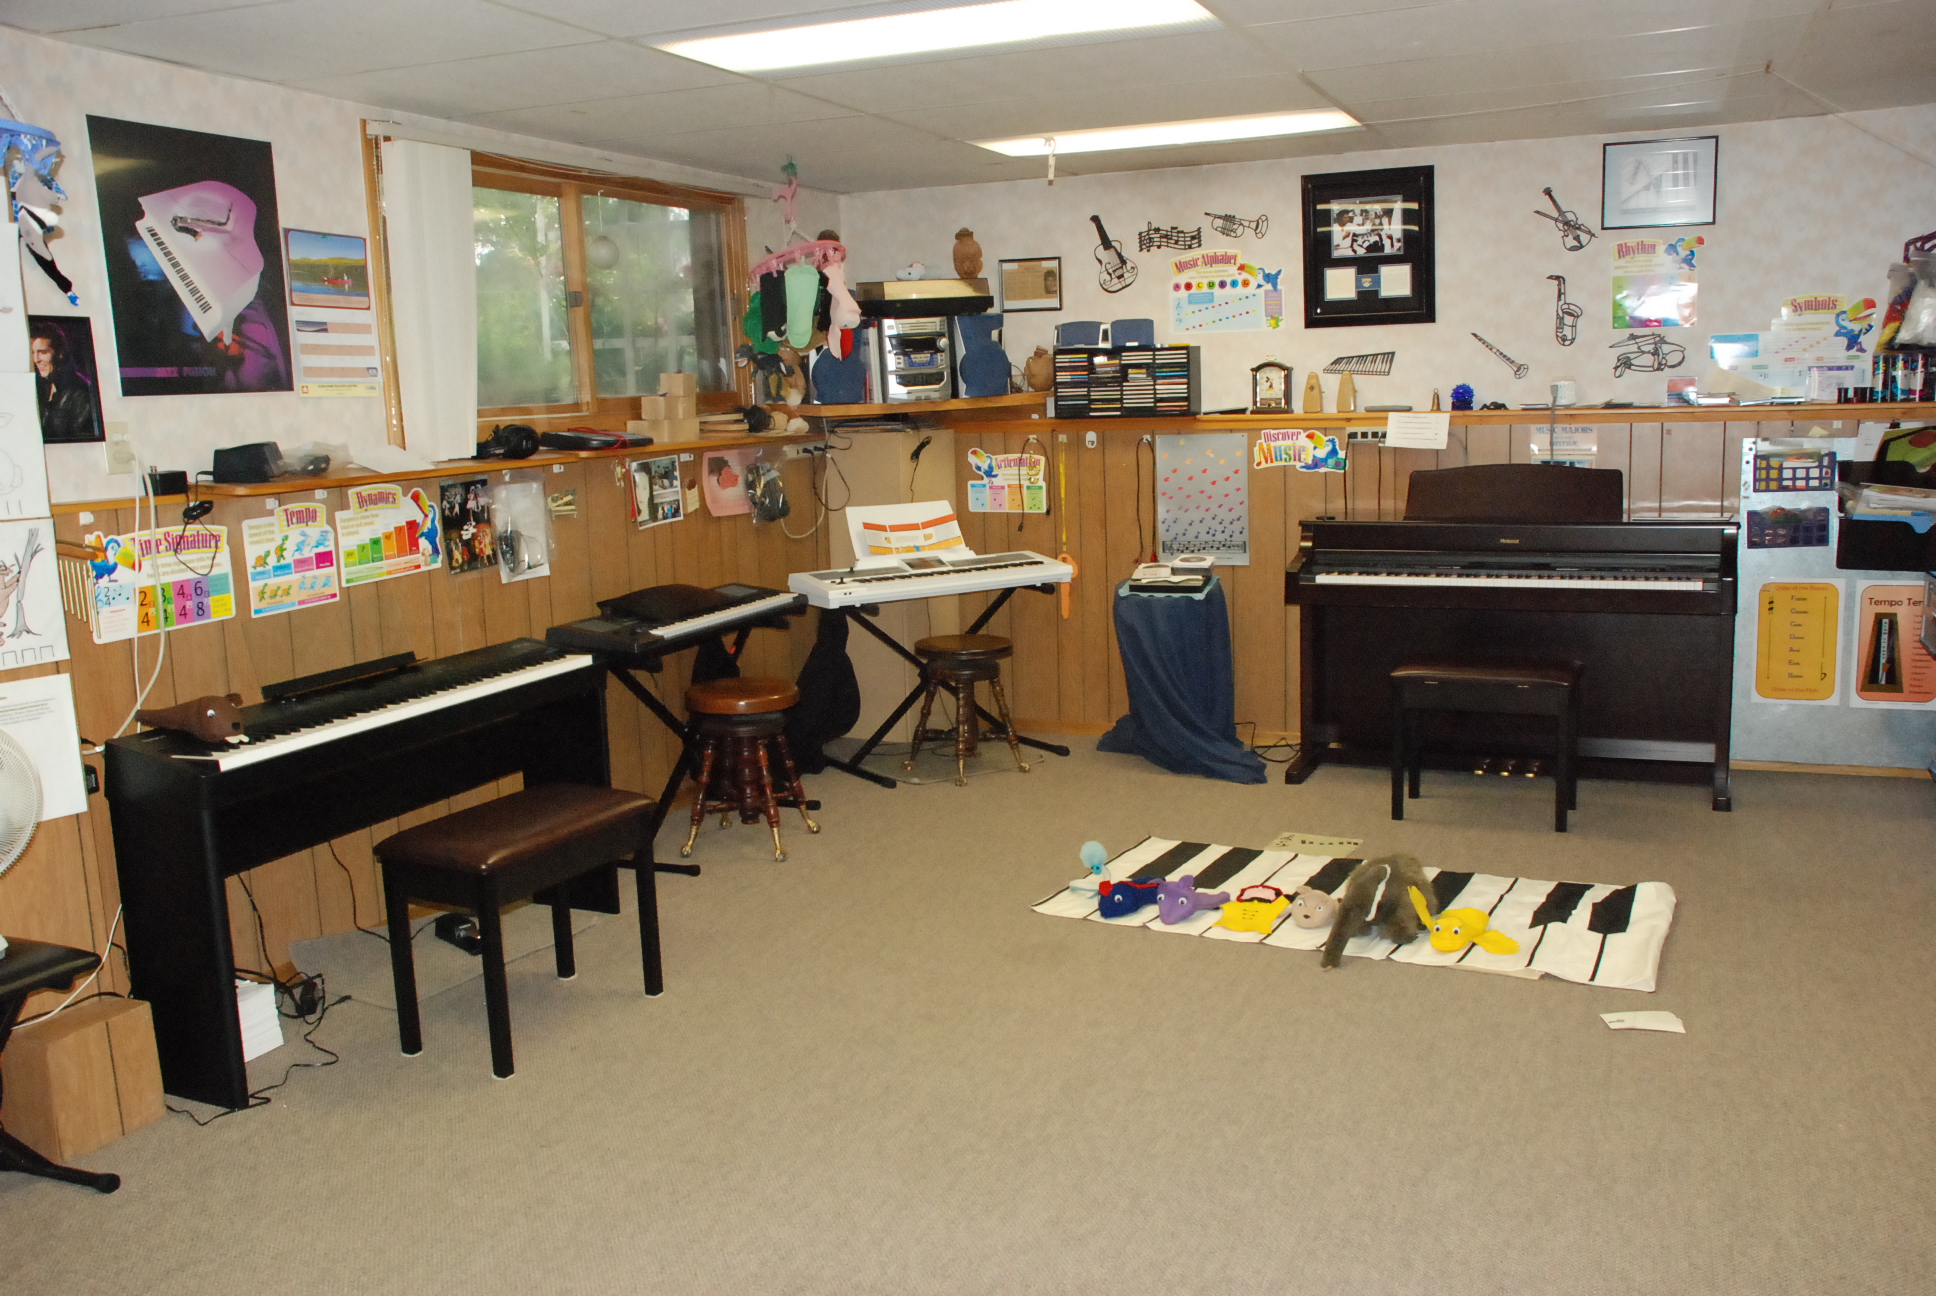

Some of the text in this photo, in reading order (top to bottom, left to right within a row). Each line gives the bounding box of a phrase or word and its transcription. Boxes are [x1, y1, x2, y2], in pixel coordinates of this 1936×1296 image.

[1617, 240, 1656, 259] Rhythm
[1174, 251, 1238, 273] Music Alphabet
[1791, 297, 1837, 315] Symbols
[1263, 431, 1302, 443] Discover
[1561, 426, 1593, 434] MAJORS
[1257, 442, 1307, 466] Music
[995, 456, 1041, 469] Articulaton
[356, 490, 397, 511] Dynamics
[284, 507, 318, 527] Tempo
[164, 531, 221, 554] Signature
[104, 586, 110, 597] 2
[177, 585, 185, 599] 4
[194, 581, 203, 596] 6
[105, 597, 111, 607] 4
[139, 591, 148, 606] 2
[1868, 597, 1924, 607] Tempo Ter
[179, 605, 187, 619] 4
[197, 601, 205, 616] 8
[141, 612, 150, 626] 4
